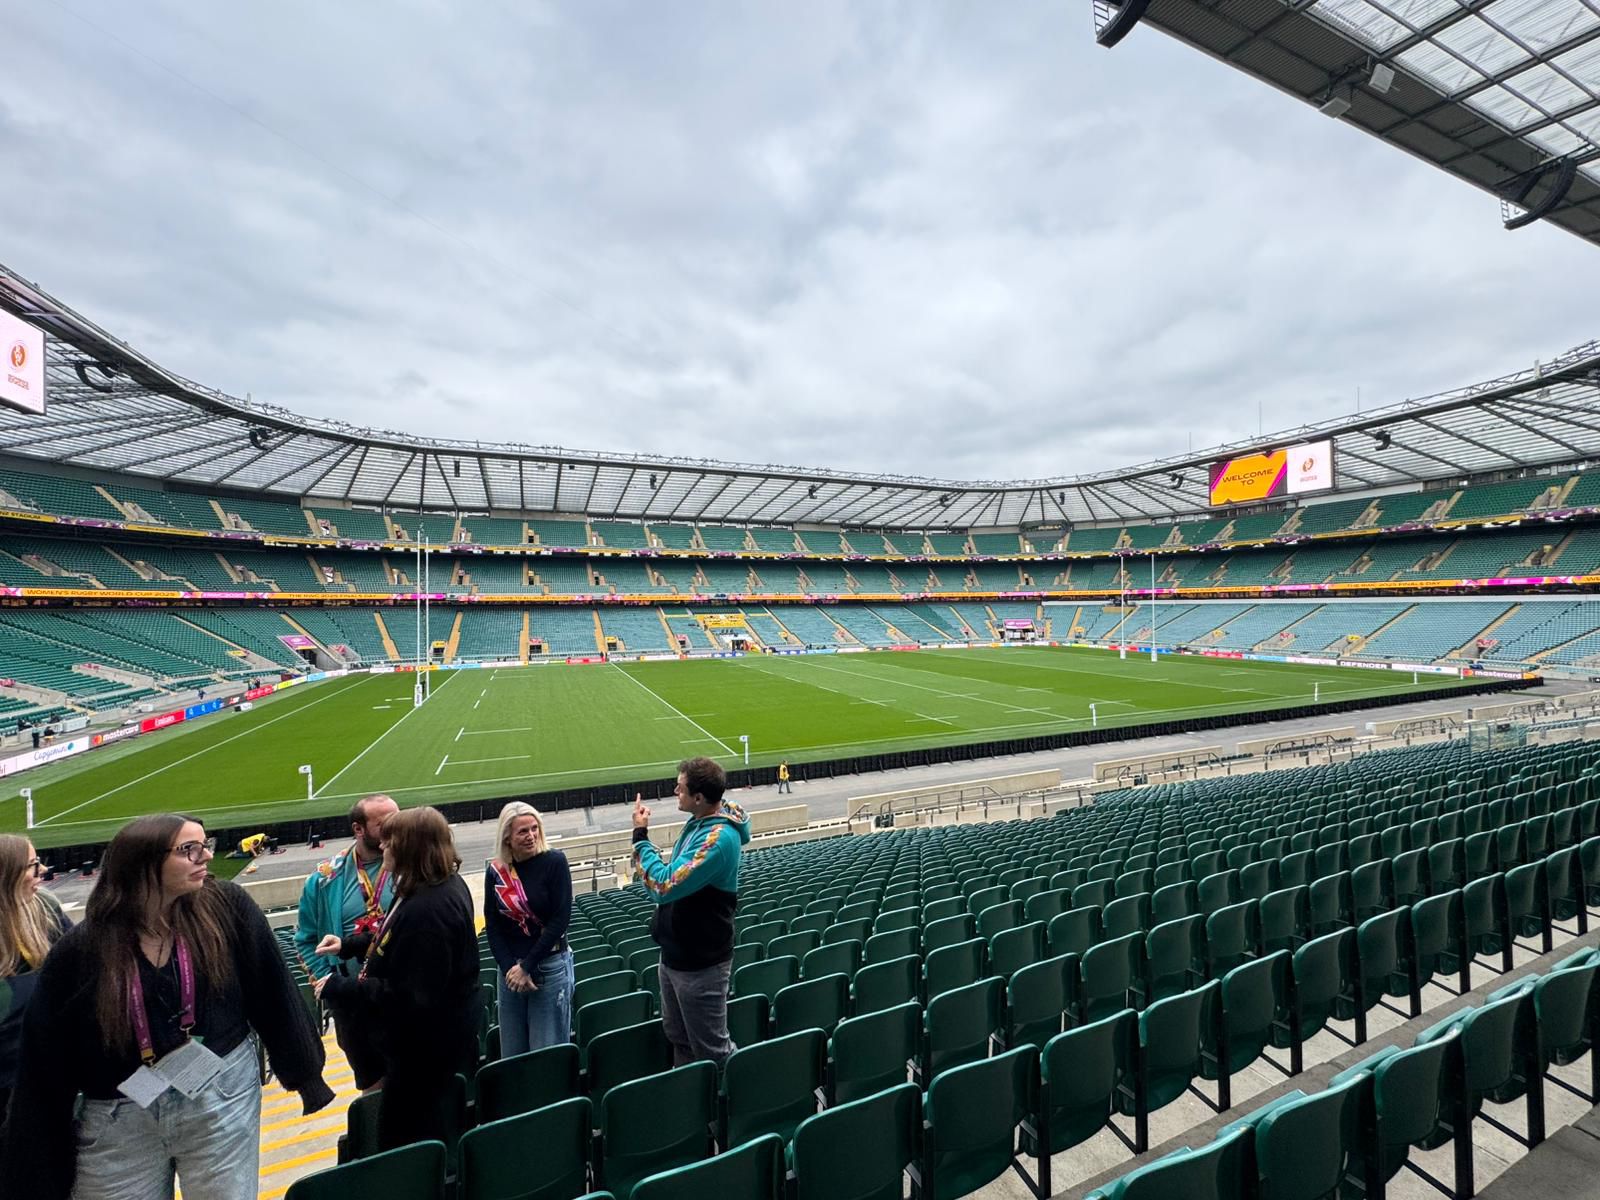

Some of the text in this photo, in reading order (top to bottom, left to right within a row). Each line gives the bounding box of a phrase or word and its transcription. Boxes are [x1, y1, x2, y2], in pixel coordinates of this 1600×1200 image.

[1223, 469, 1273, 483] WELCOME
[11, 512, 41, 520] STADIUM
[1340, 661, 1387, 669] DEFENDER
[1474, 671, 1522, 679] mastercard
[103, 725, 139, 740] mastercard
